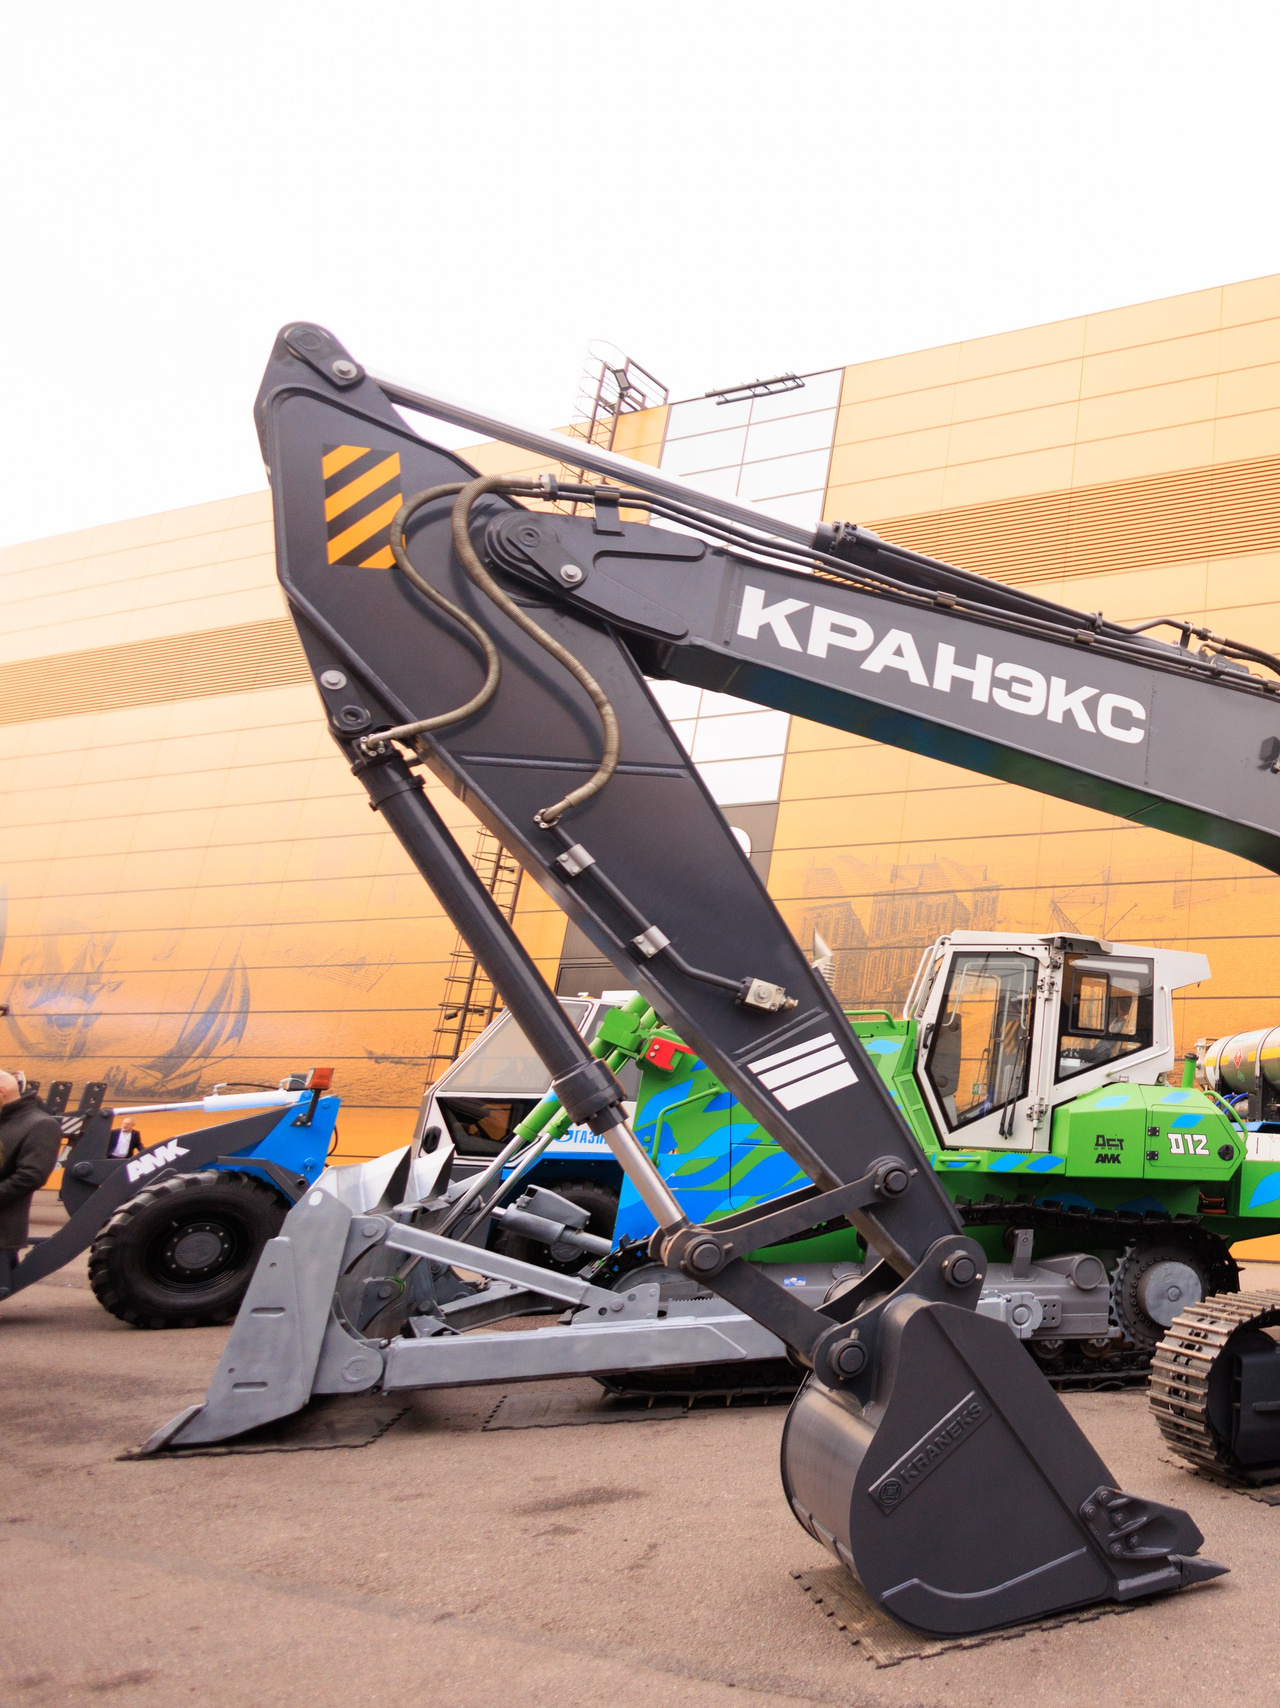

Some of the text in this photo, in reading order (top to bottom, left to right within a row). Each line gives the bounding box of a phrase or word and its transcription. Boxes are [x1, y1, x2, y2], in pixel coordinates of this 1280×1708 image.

[737, 585, 1146, 744] КРАНЭКС
[573, 1130, 607, 1144] ГАЗП
[1167, 1133, 1210, 1155] D12
[127, 1138, 190, 1182] АМК
[1095, 1153, 1121, 1164] АМК
[900, 1401, 982, 1484] KRANEKS
